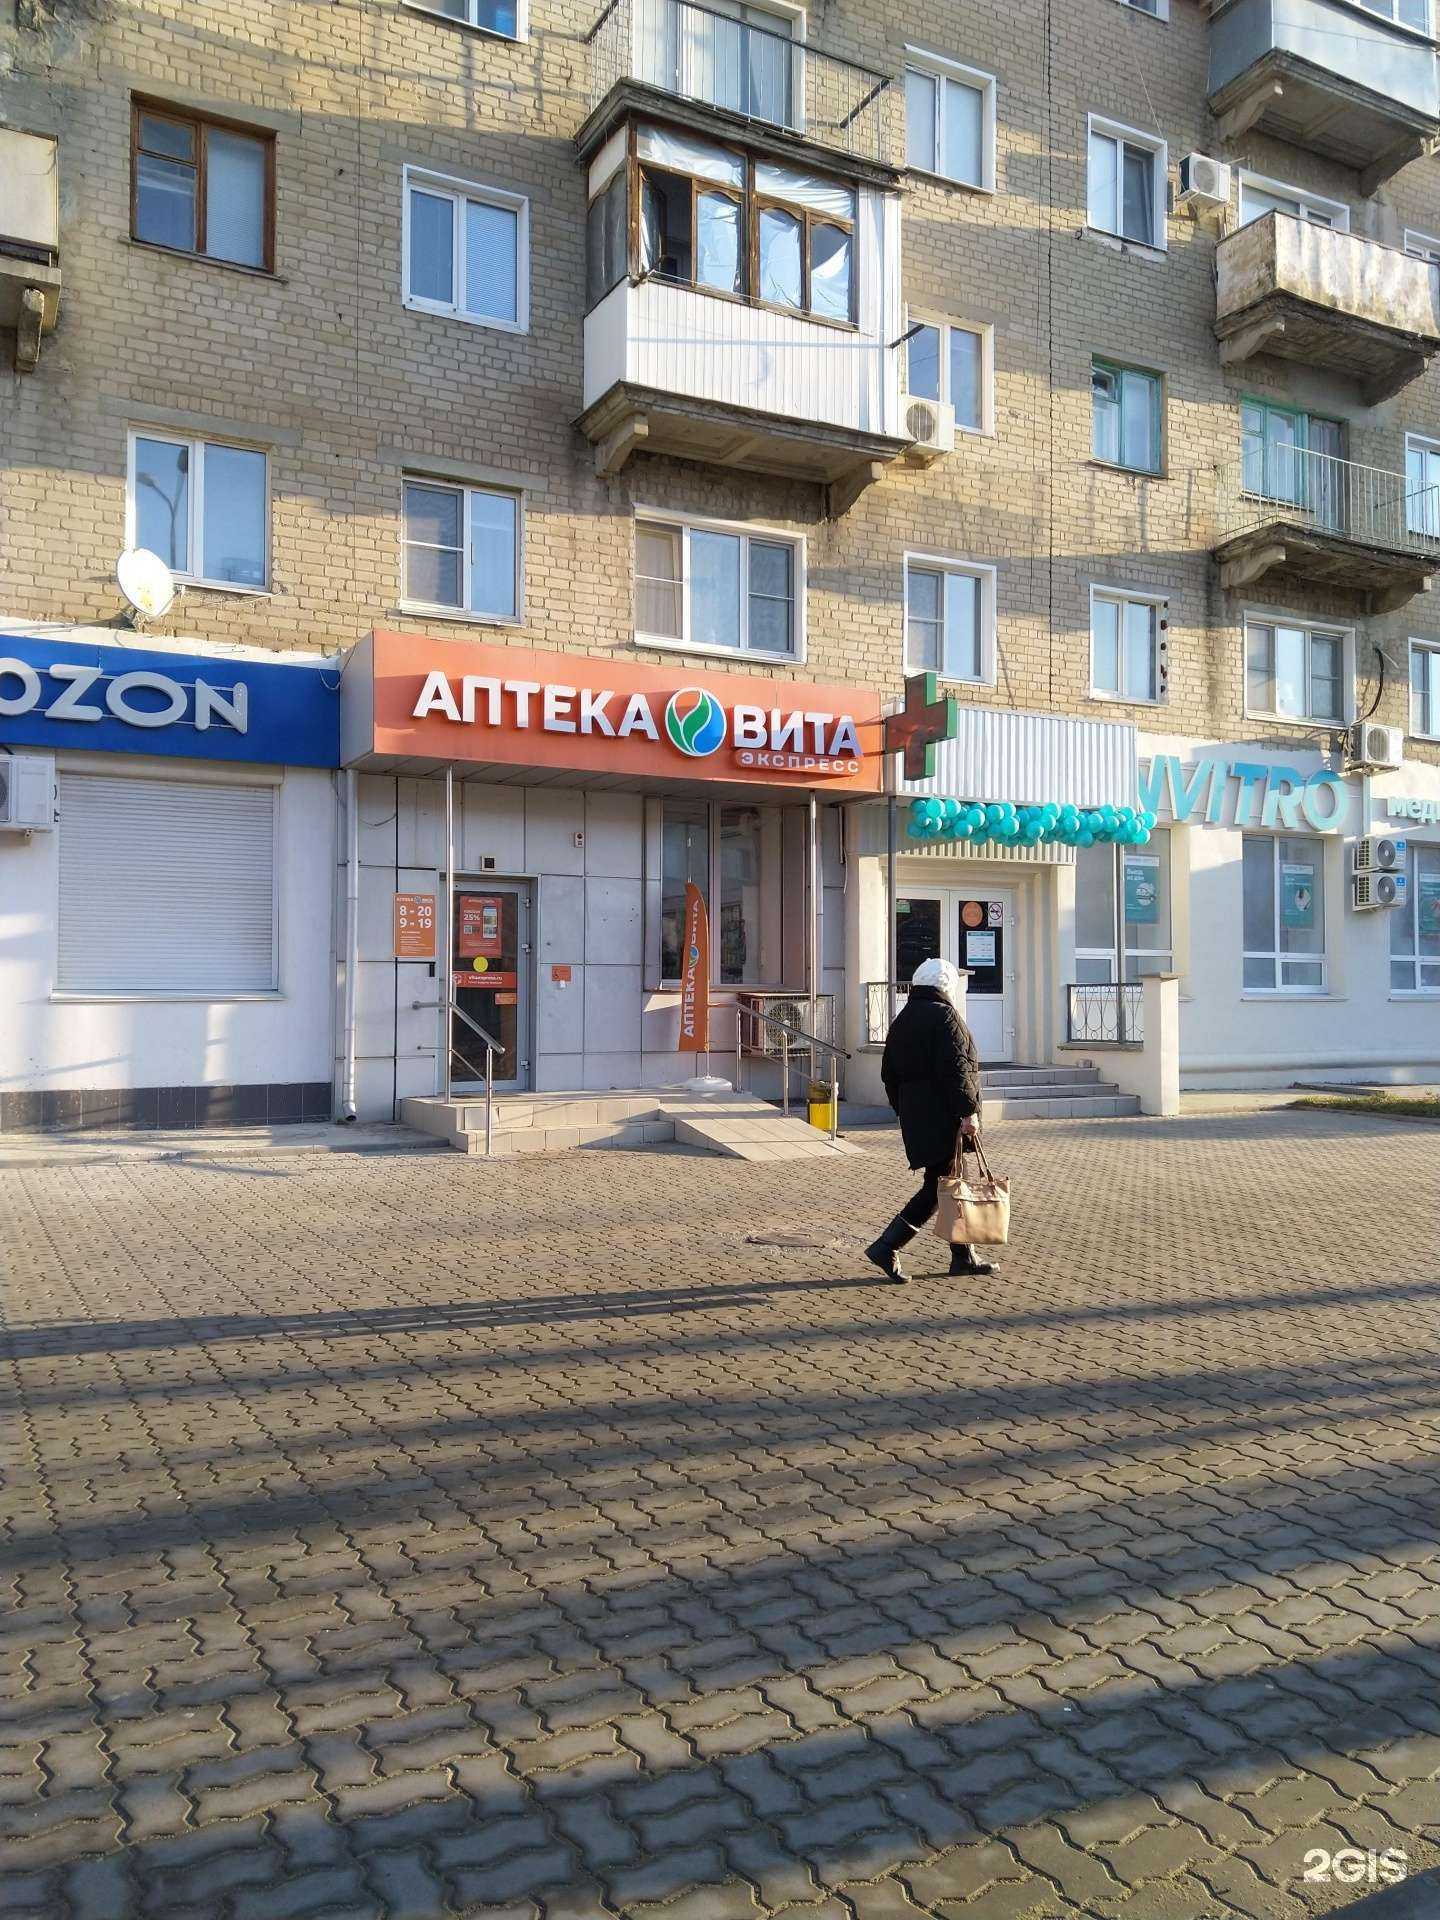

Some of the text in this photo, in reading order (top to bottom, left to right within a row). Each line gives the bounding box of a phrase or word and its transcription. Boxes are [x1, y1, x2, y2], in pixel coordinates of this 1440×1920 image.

[0, 657, 248, 735] OZON
[412, 670, 865, 758] АПТЕКА ВИТА
[741, 752, 859, 773] ЭКСПРЕСС
[399, 905, 407, 916] 8
[417, 905, 432, 917] 20
[399, 917, 407, 928] 9
[418, 918, 432, 929] 19
[684, 967, 696, 1037] АПТЕКА
